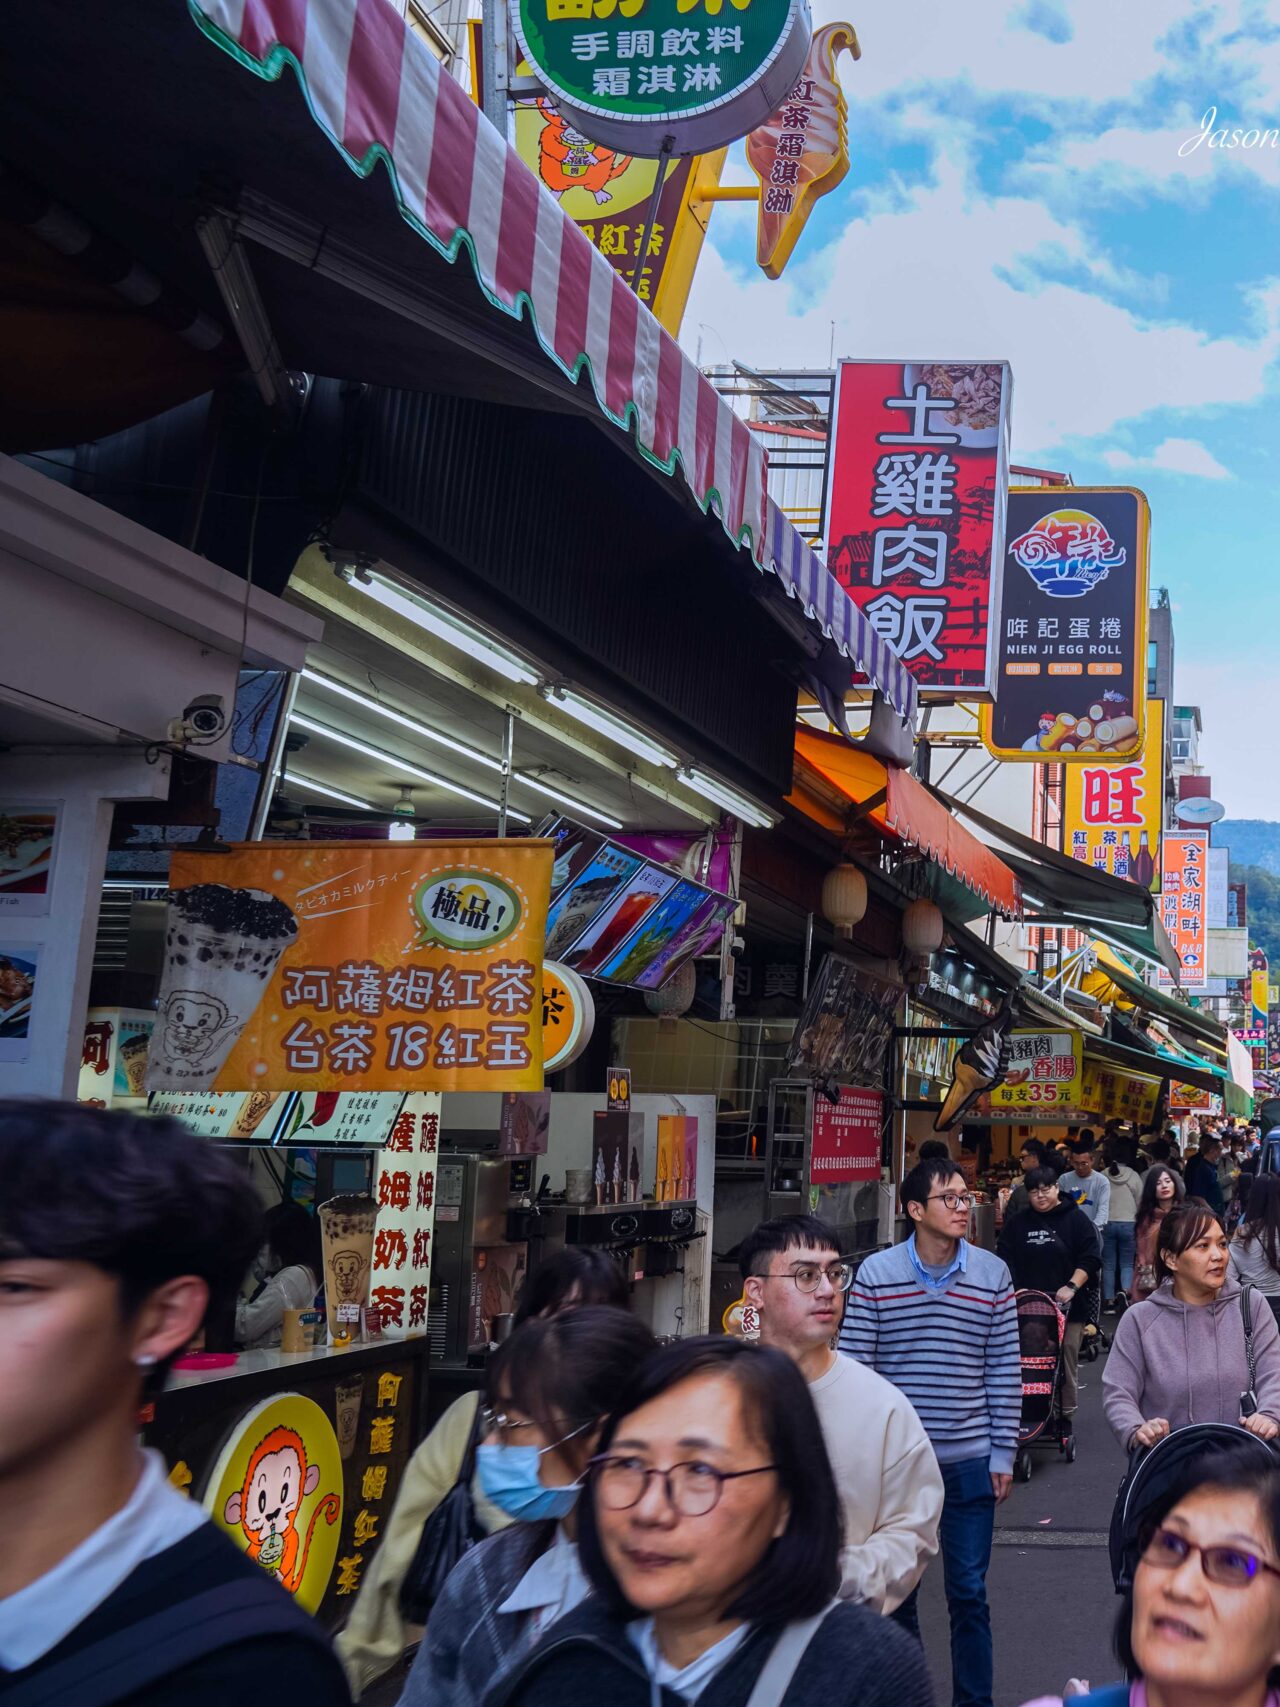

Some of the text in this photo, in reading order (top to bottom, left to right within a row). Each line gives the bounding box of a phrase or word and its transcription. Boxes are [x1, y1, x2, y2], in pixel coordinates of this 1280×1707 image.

[571, 26, 744, 61] 手調飲料
[592, 62, 722, 97] 霜淇淋
[865, 384, 960, 661] 土雞肉飯
[1006, 617, 1122, 639] 哖記蛋捲
[1006, 645, 1122, 654] NIEN JI EGG ROLL
[1083, 767, 1144, 824] 旺
[1073, 830, 1118, 845] 紅茶
[1073, 846, 1128, 860] 高山茶
[1181, 843, 1203, 938] 全家湖畔
[430, 886, 507, 933] 極品!
[285, 964, 533, 1014] 阿薩姆紅茶
[1032, 1056, 1077, 1079] 香腸
[210, 1126, 221, 1136] 80
[217, 1109, 228, 1118] 80
[336, 1371, 403, 1595] 阿薩姆紅茶
